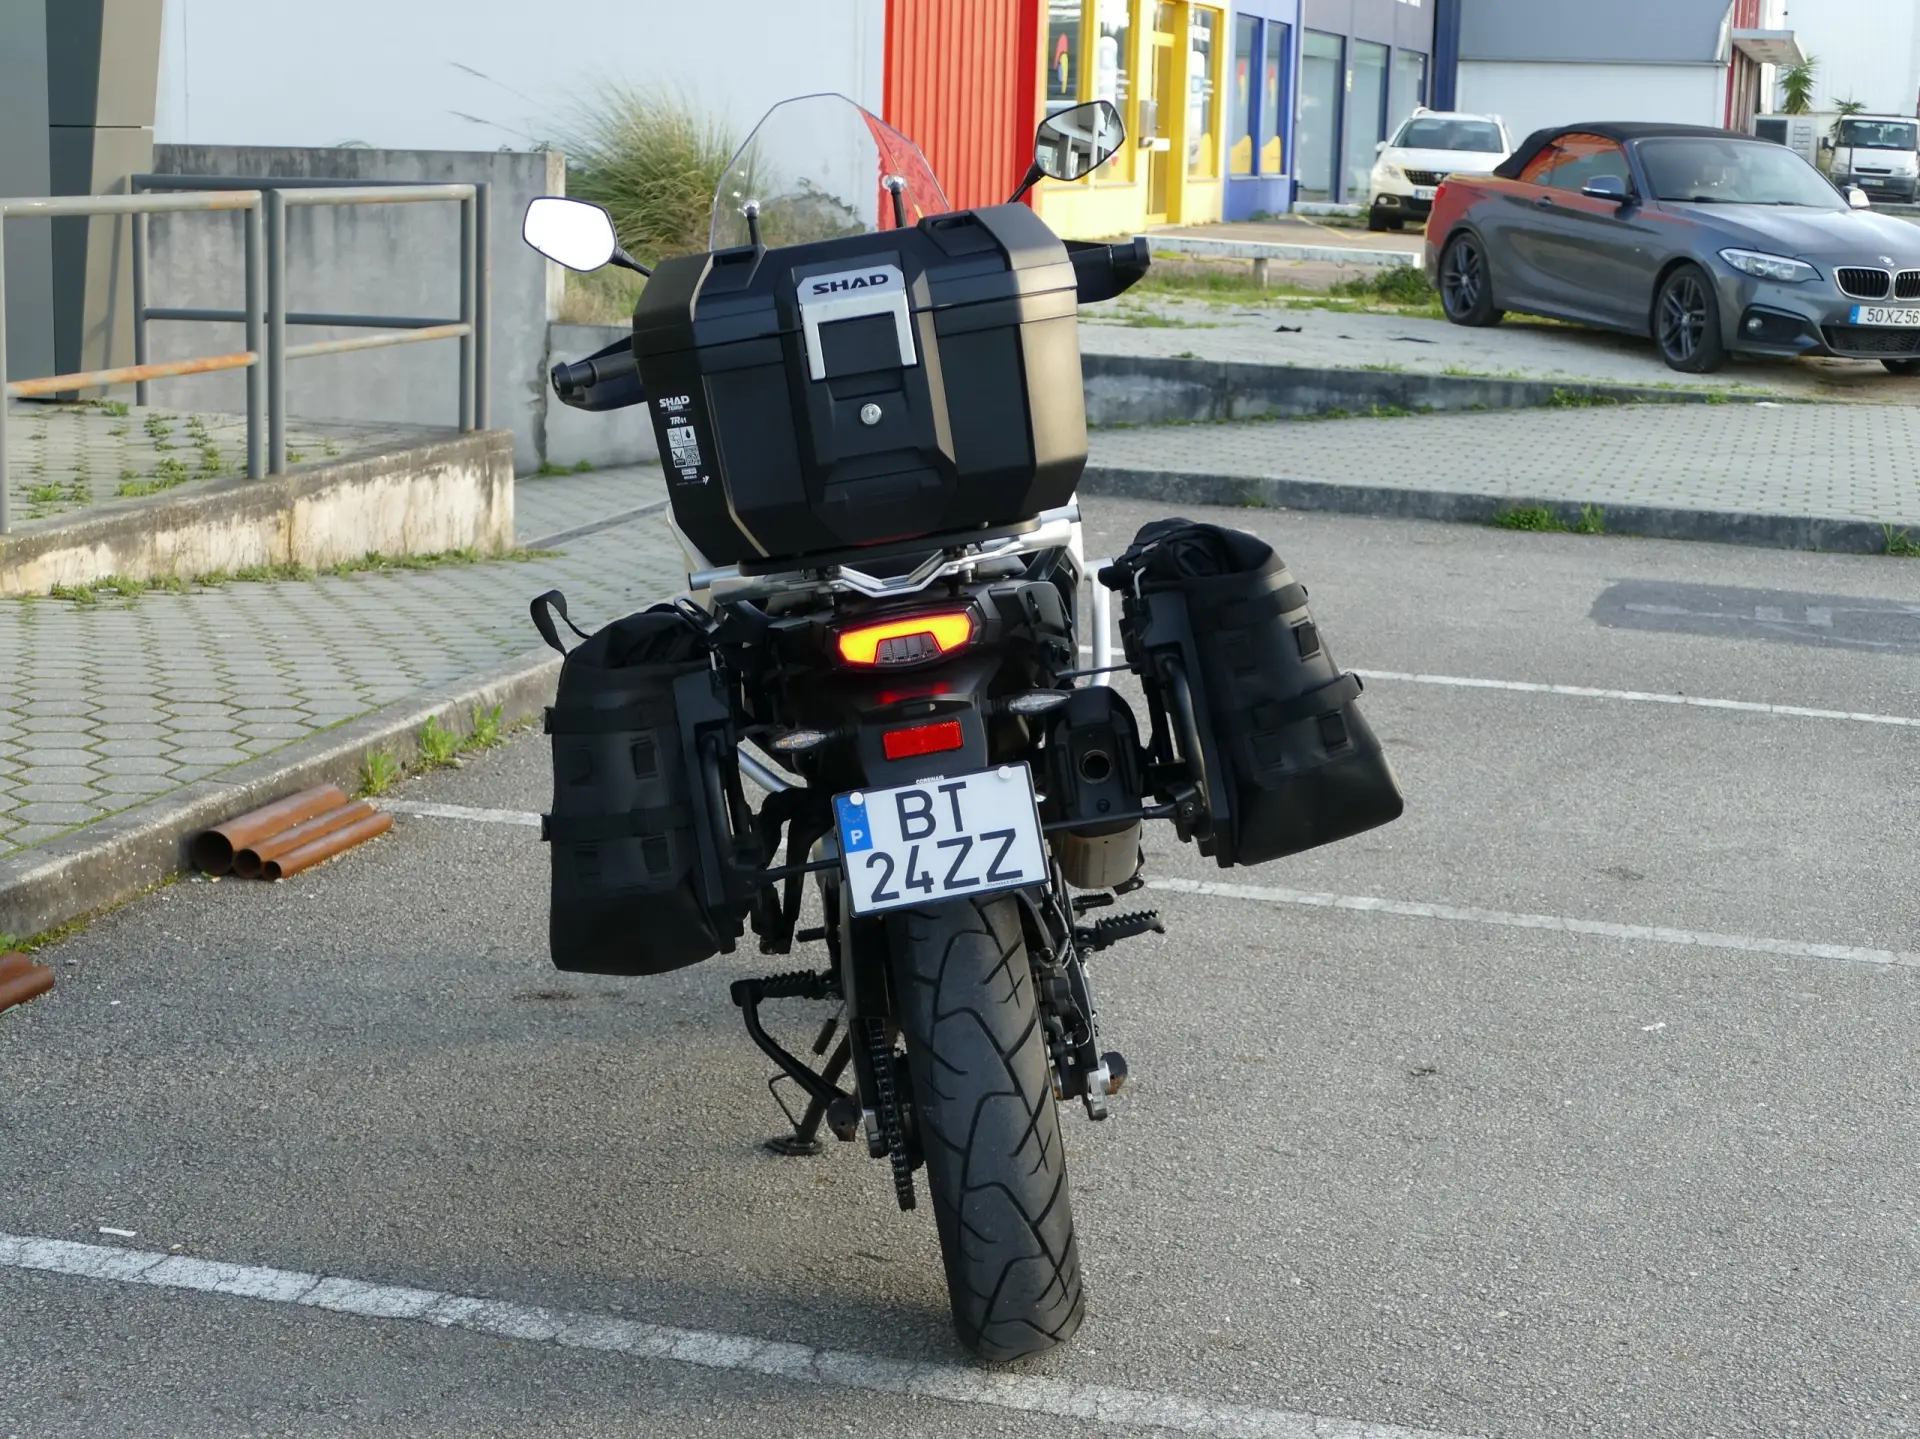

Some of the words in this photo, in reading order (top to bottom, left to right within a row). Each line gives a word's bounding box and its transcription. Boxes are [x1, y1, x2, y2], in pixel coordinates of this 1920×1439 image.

[812, 274, 889, 296] SHAD
[659, 395, 690, 408] SHAD
[895, 781, 967, 842] BT
[850, 829, 864, 846] P
[866, 828, 1024, 903] 24ZZ
